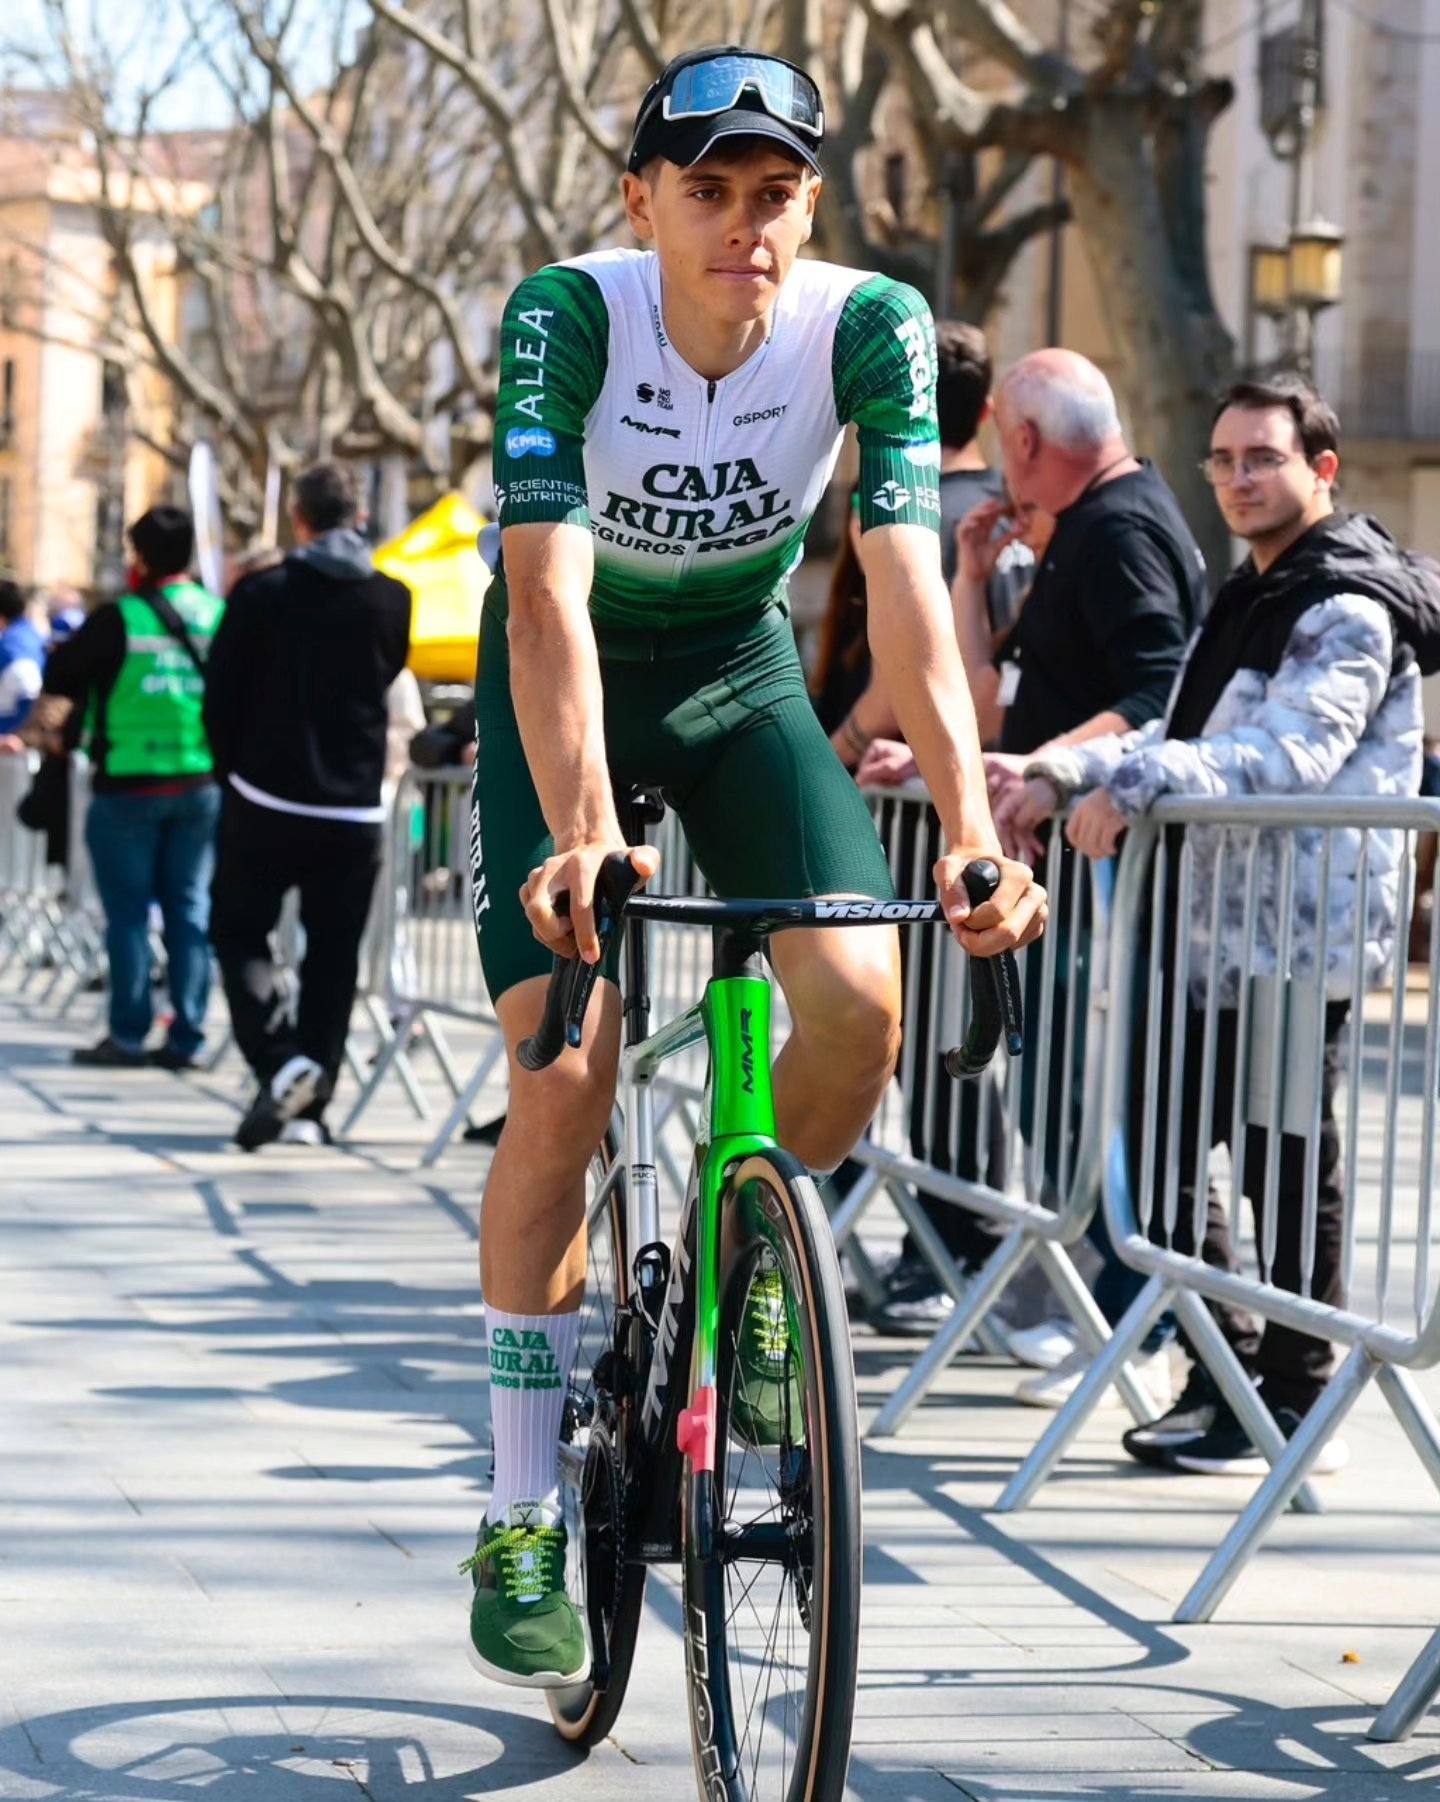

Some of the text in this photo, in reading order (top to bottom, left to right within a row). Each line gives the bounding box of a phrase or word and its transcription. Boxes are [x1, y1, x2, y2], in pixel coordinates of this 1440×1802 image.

[515, 308, 554, 421] ALEA
[620, 415, 681, 439] MMR
[733, 405, 788, 427] GSPORT
[508, 433, 553, 451] KMC
[642, 458, 767, 501] CAJA
[600, 488, 792, 541] RURAL
[590, 515, 796, 556] EGUROS RGA
[740, 1007, 754, 1095] MMR
[492, 1327, 550, 1350] CAJA
